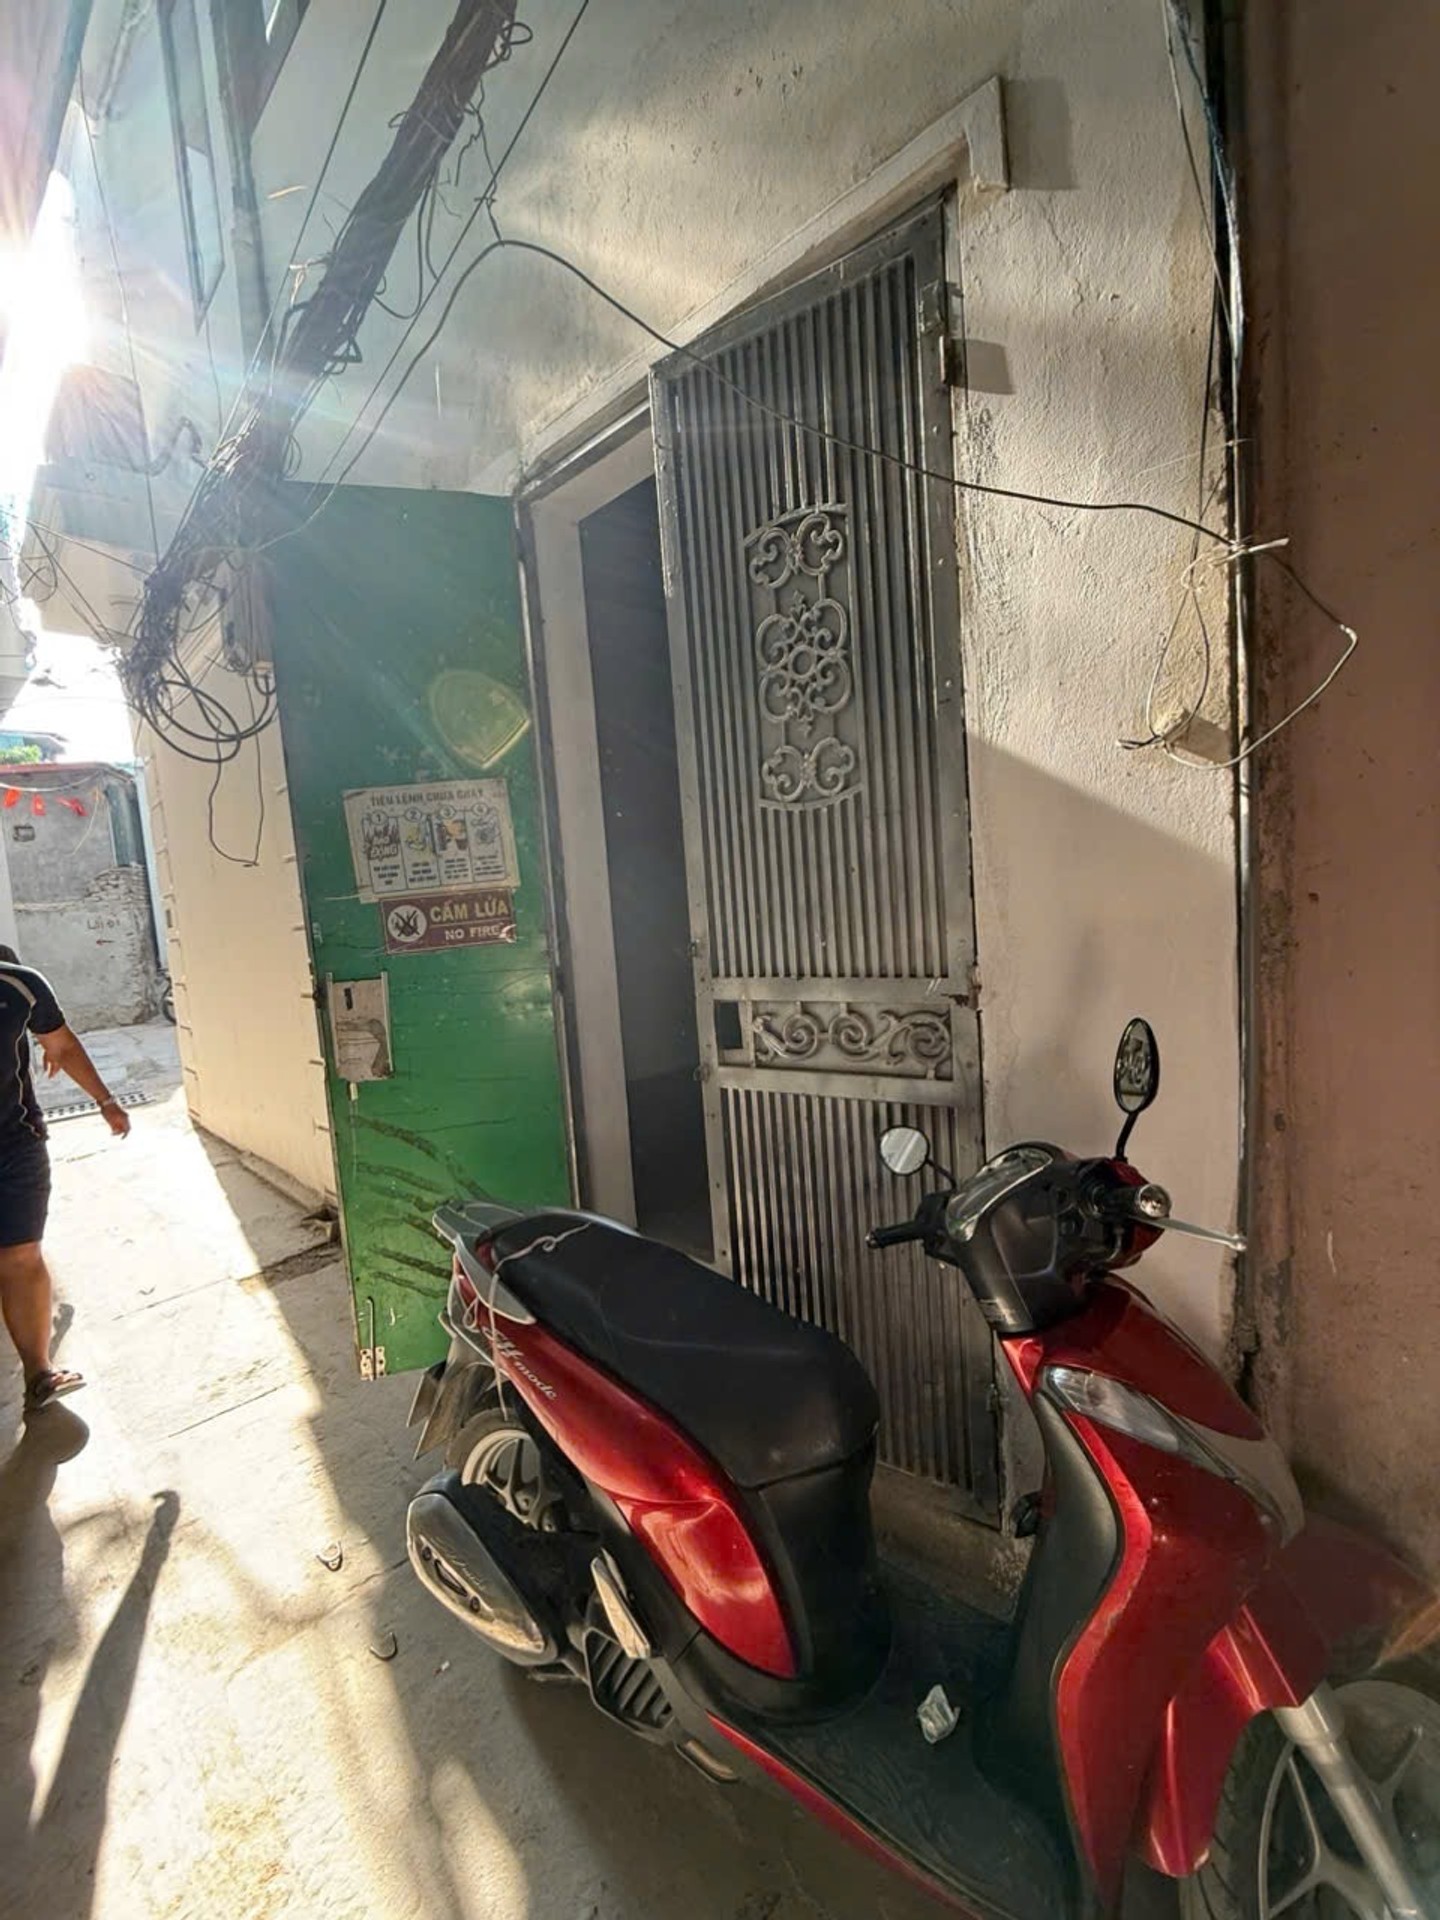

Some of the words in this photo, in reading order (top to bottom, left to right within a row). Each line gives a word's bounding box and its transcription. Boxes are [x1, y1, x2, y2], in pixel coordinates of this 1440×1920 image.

[475, 896, 509, 918] LỬA
[444, 929, 465, 941] NO
[469, 925, 501, 938] FIRE
